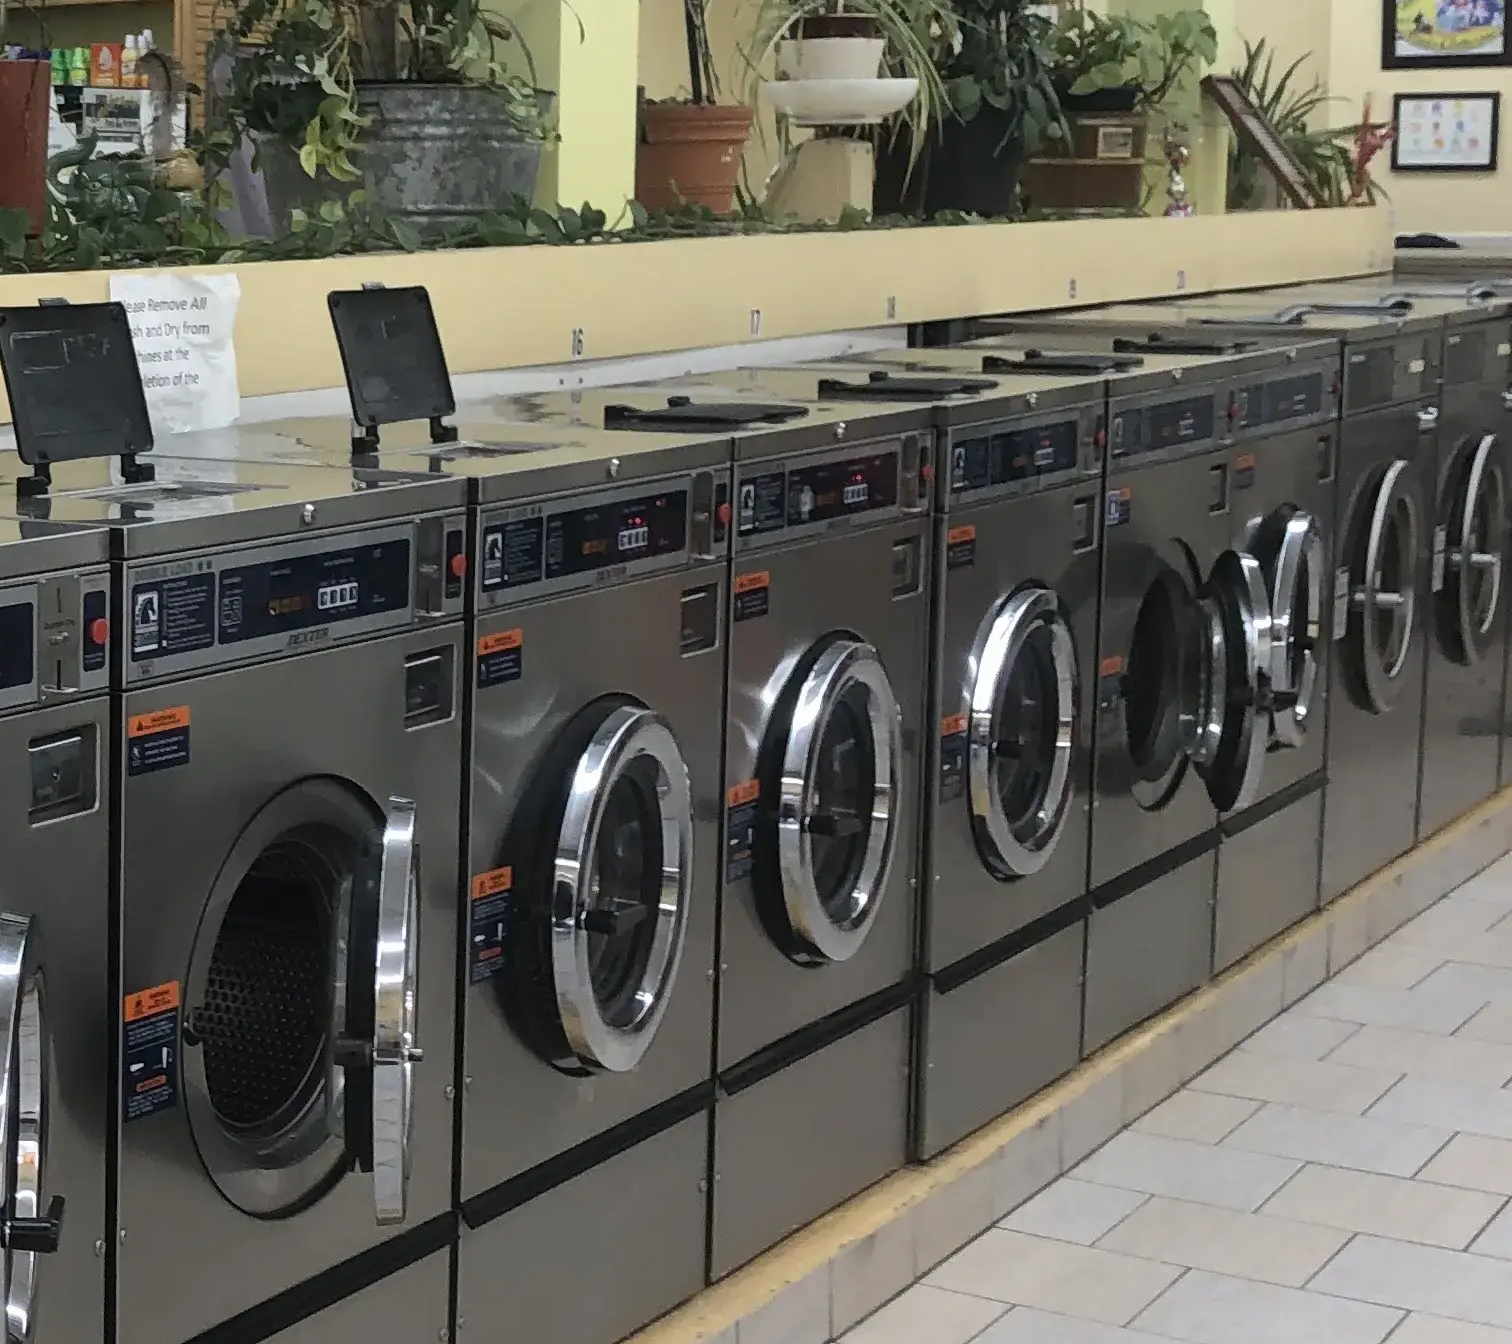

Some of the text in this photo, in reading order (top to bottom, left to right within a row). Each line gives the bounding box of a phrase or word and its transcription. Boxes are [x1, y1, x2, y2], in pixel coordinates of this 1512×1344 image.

[148, 298, 187, 312] Remove
[190, 296, 208, 311] All
[145, 322, 162, 337] and
[164, 322, 180, 340] Dry
[183, 320, 210, 335] from
[184, 372, 199, 386] the
